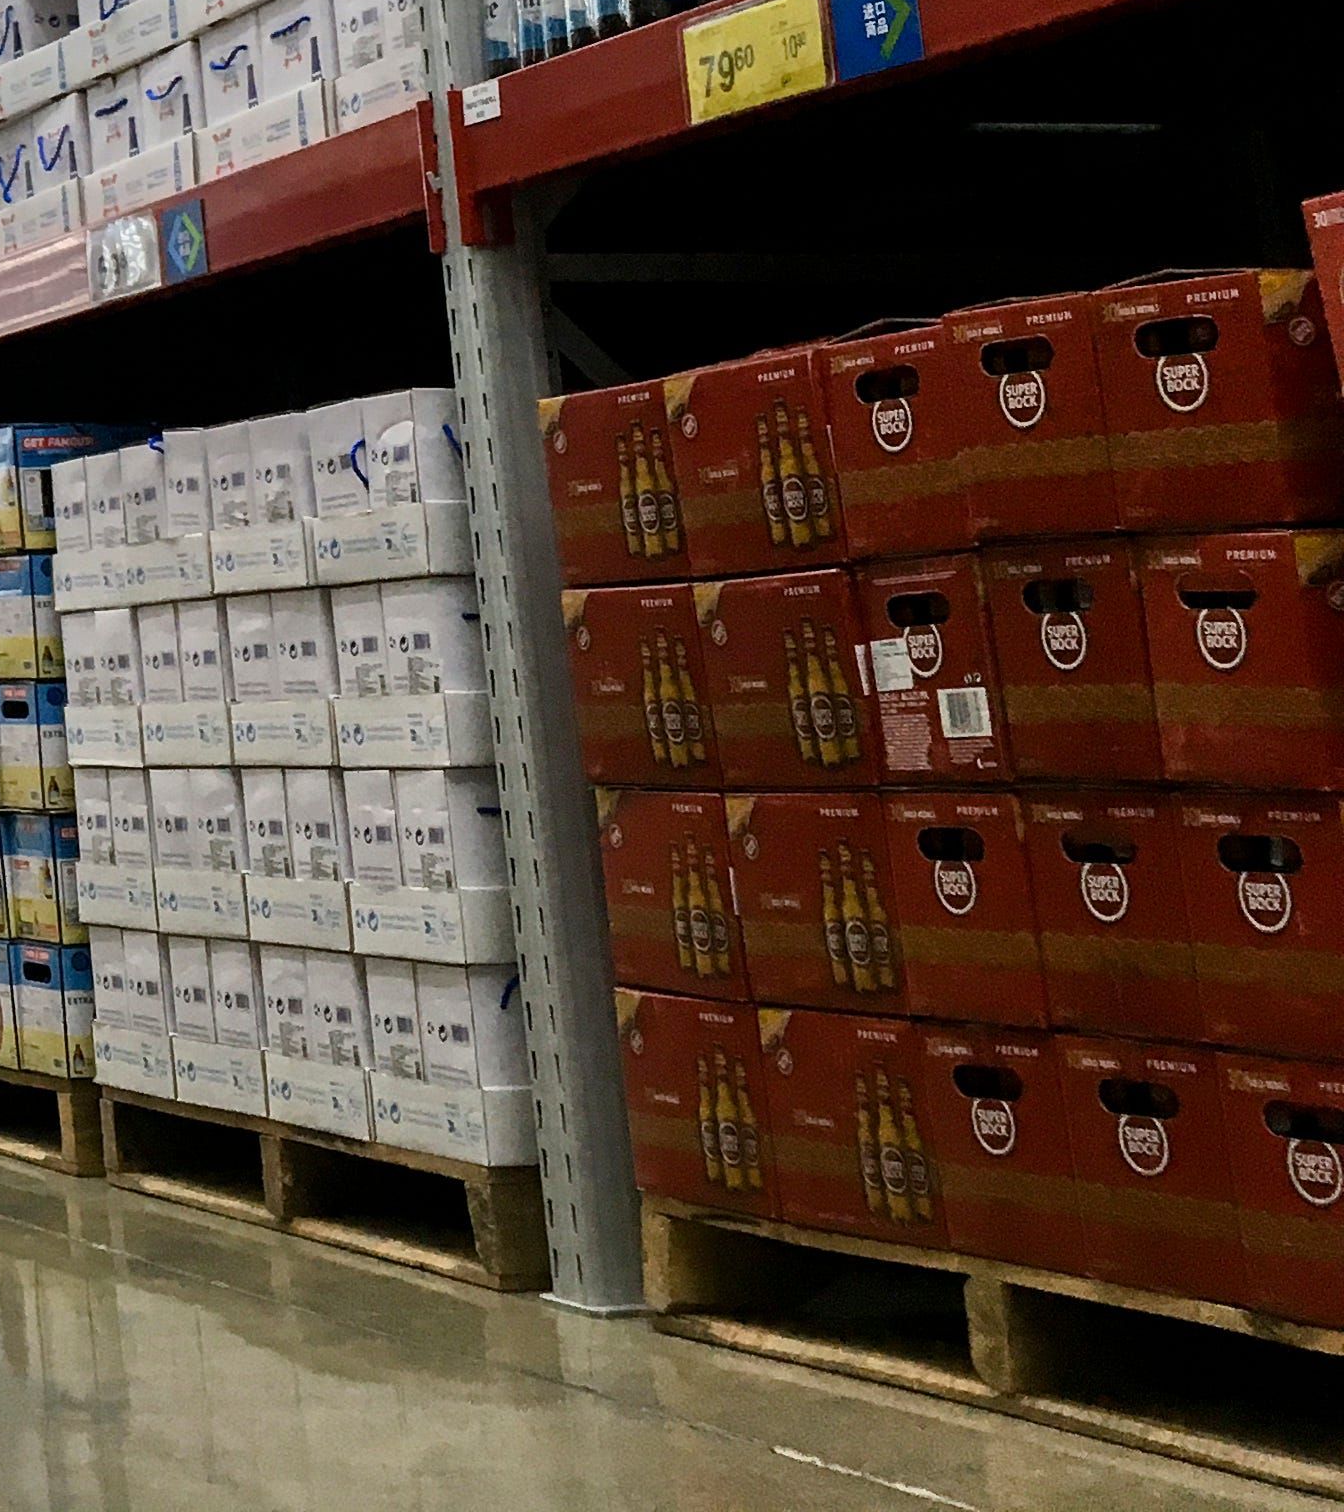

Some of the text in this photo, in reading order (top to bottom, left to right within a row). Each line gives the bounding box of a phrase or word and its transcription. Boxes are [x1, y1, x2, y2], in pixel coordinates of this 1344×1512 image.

[862, 0, 887, 20] 进口
[865, 18, 889, 38] 商品
[1186, 288, 1239, 304] PREMIUM
[1026, 310, 1073, 325] PREMIUM
[894, 340, 935, 356] PREMIUM
[1162, 364, 1200, 380] SUPER
[1005, 382, 1038, 399] SUPER
[1166, 377, 1200, 393] BOCK
[1008, 395, 1038, 410] BOCK
[877, 408, 906, 424] SUPER
[879, 422, 907, 435] BOCK
[23, 437, 44, 449] GET
[1046, 624, 1079, 639] SUPER
[1203, 621, 1238, 636] SUPER
[908, 633, 936, 648] SUPER
[1050, 637, 1079, 651] BOCK
[1206, 634, 1238, 649] BOCK
[1295, 1152, 1334, 1171] SUPER
